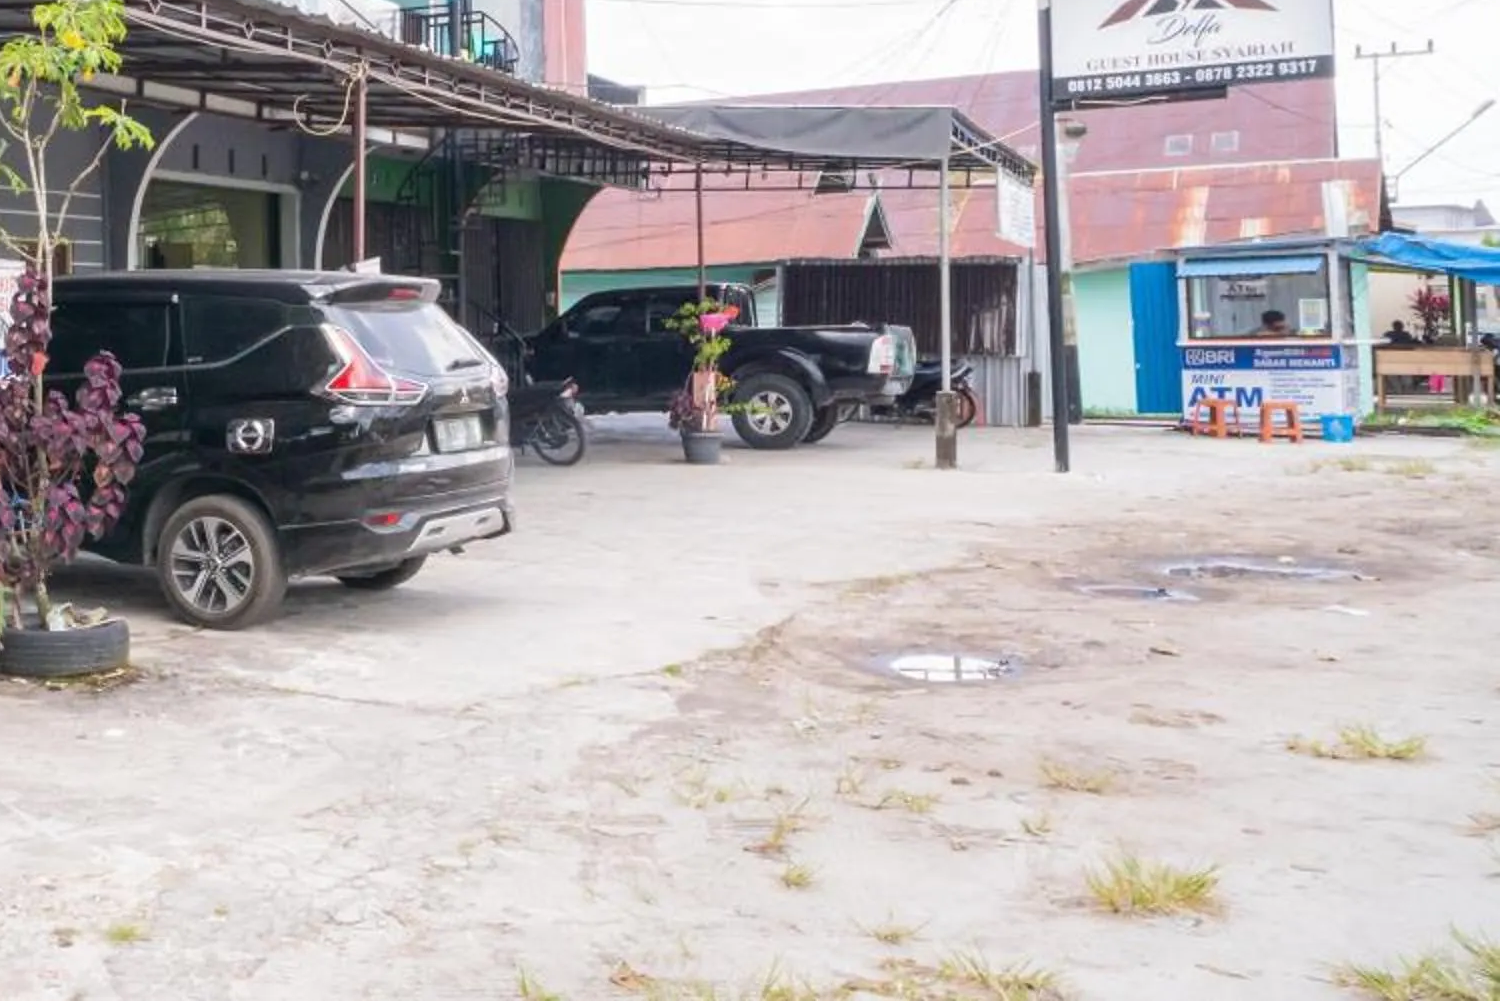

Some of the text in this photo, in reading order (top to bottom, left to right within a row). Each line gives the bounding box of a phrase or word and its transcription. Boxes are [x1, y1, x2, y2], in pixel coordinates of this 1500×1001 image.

[1086, 41, 1295, 72] GUEST HOUSE SYARIAH
[1205, 350, 1235, 364] BRI
[1191, 374, 1225, 384] MINI
[1188, 386, 1263, 407] ATM
